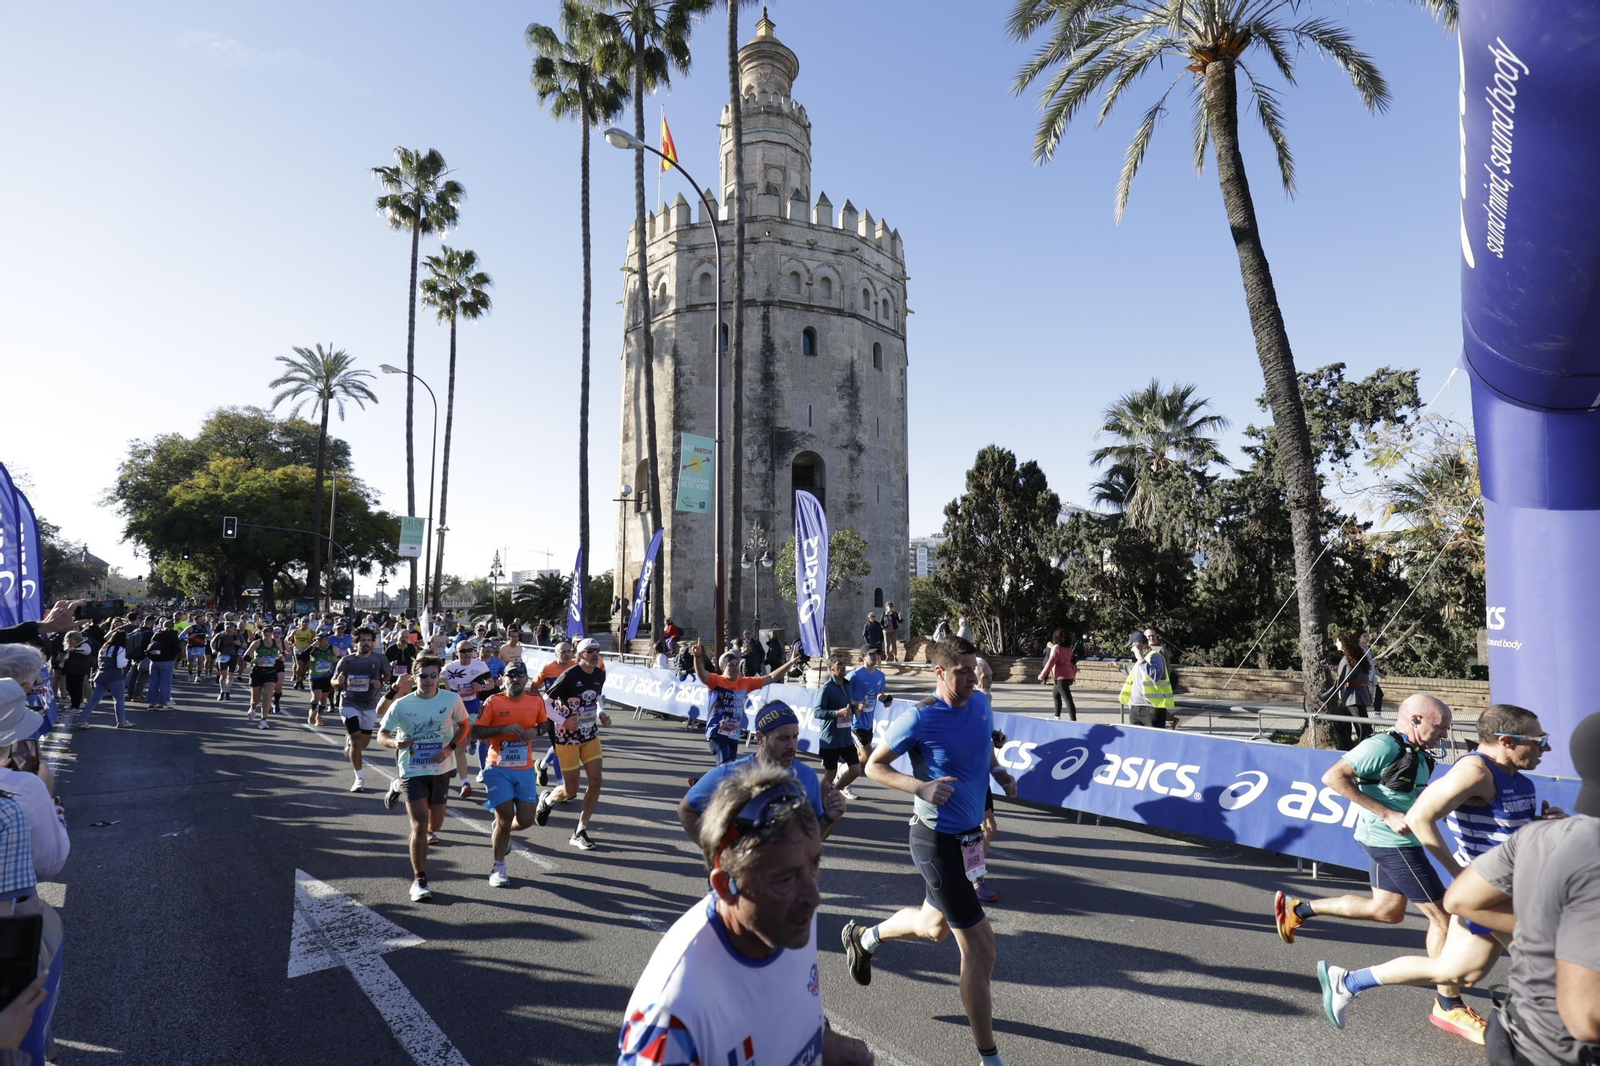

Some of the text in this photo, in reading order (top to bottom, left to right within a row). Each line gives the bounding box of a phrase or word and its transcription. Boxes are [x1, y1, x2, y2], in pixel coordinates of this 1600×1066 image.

[1483, 36, 1530, 259] sound mind, sound body
[694, 446, 713, 455] MATCH
